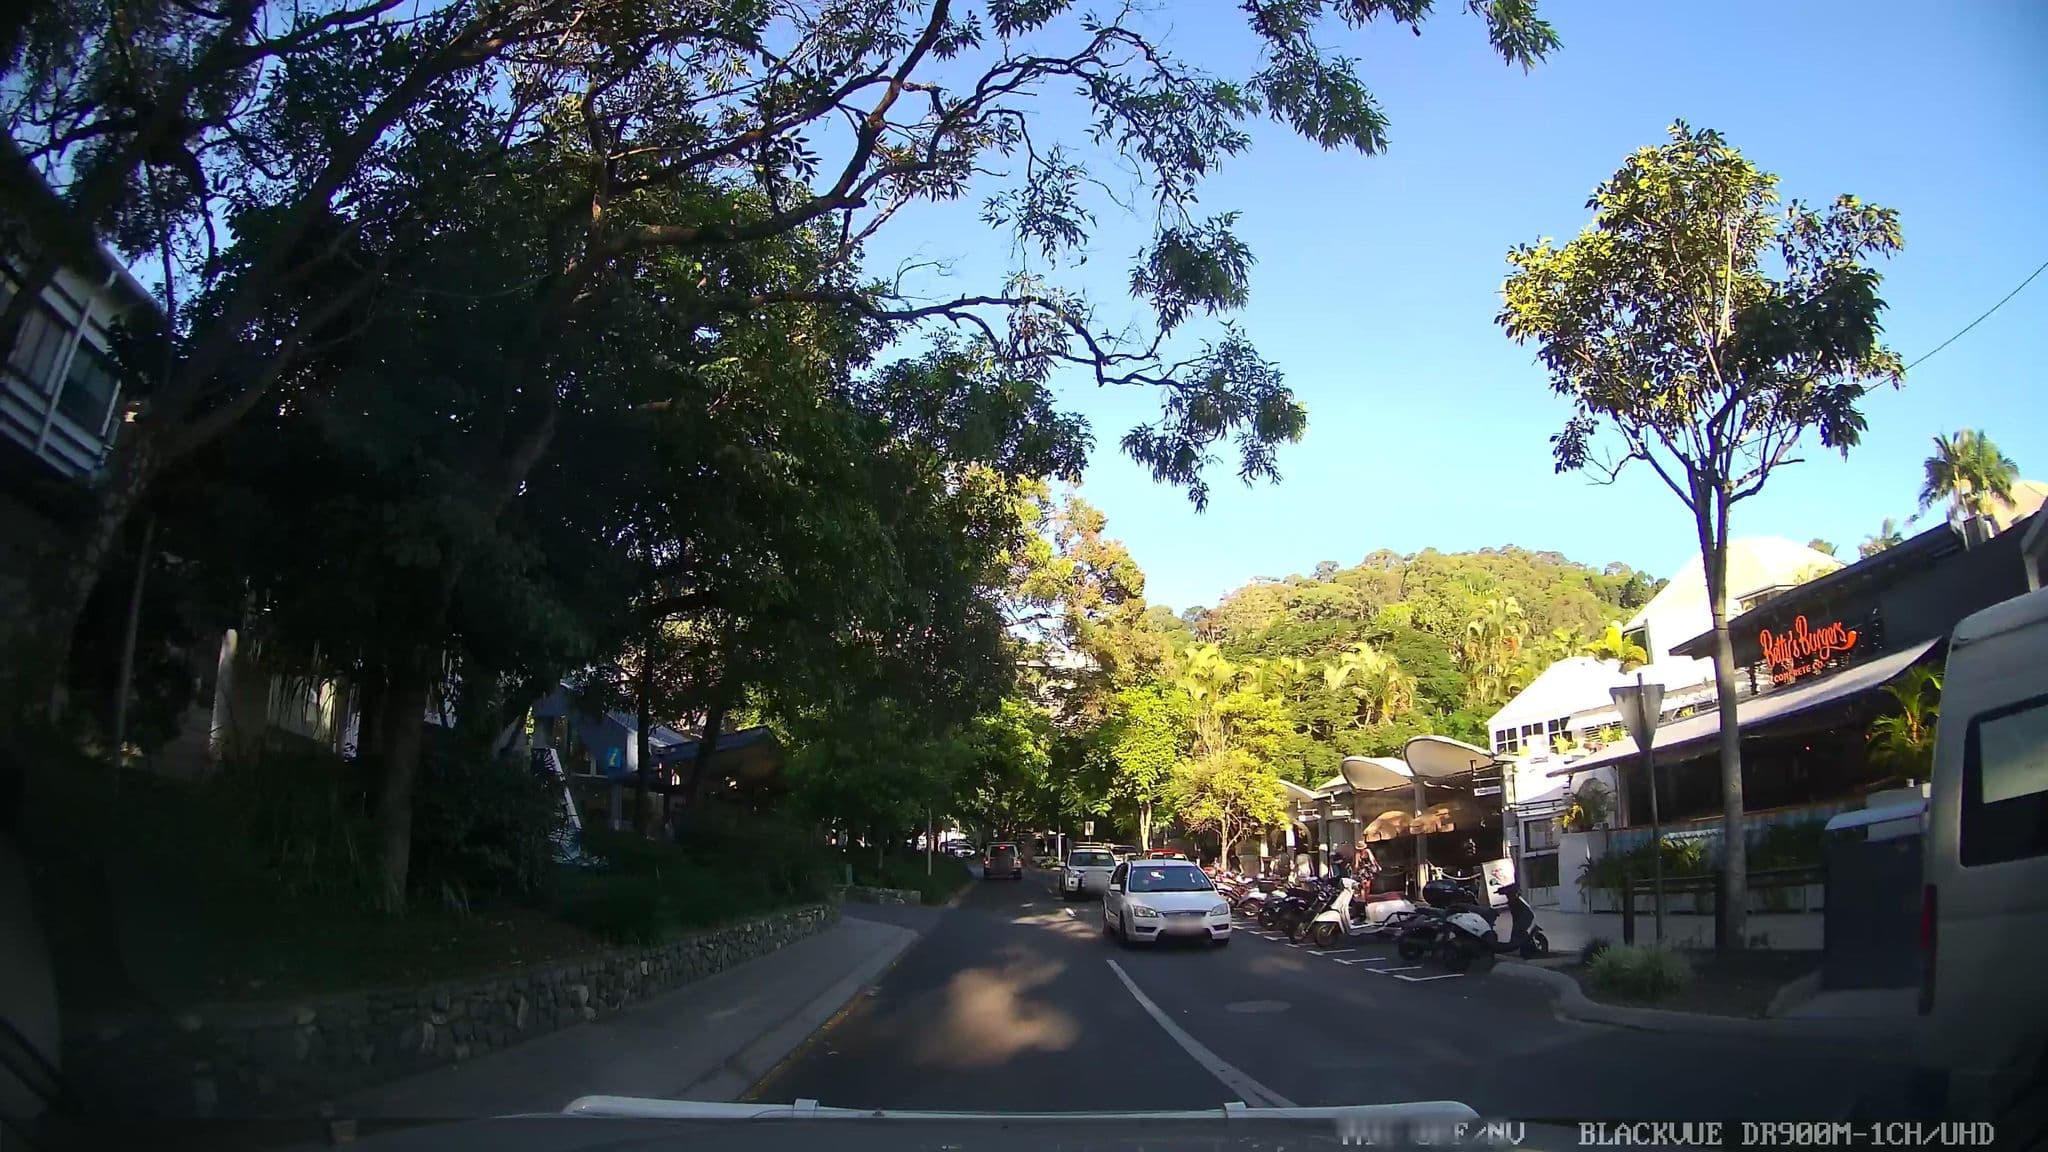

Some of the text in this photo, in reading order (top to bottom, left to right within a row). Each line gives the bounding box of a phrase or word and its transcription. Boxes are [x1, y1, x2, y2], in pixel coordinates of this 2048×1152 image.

[1760, 615, 1856, 668] Betty's Burgers
[1773, 664, 1811, 683] CONCRETE
